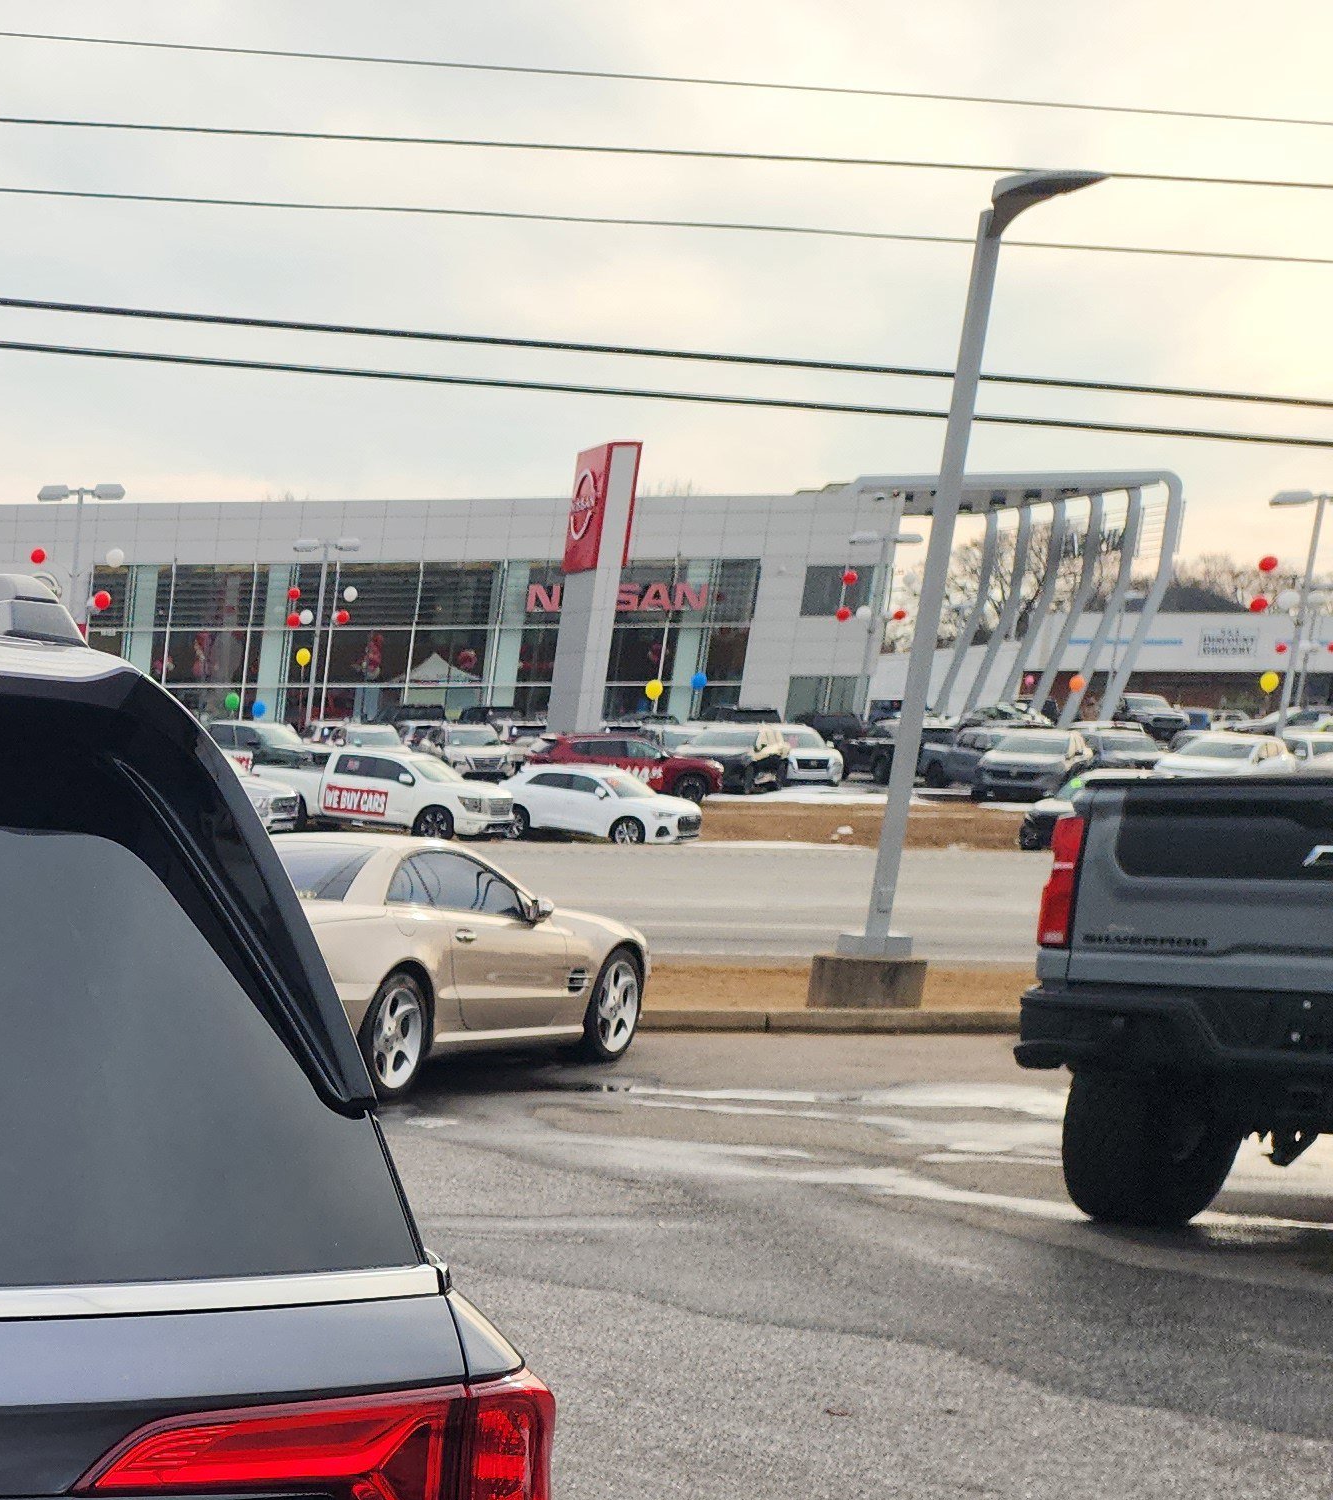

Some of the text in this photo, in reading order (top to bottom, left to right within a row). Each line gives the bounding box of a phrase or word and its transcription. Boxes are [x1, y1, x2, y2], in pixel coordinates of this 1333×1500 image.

[525, 582, 709, 612] NSAN
[325, 787, 385, 814] WE BUY CARS
